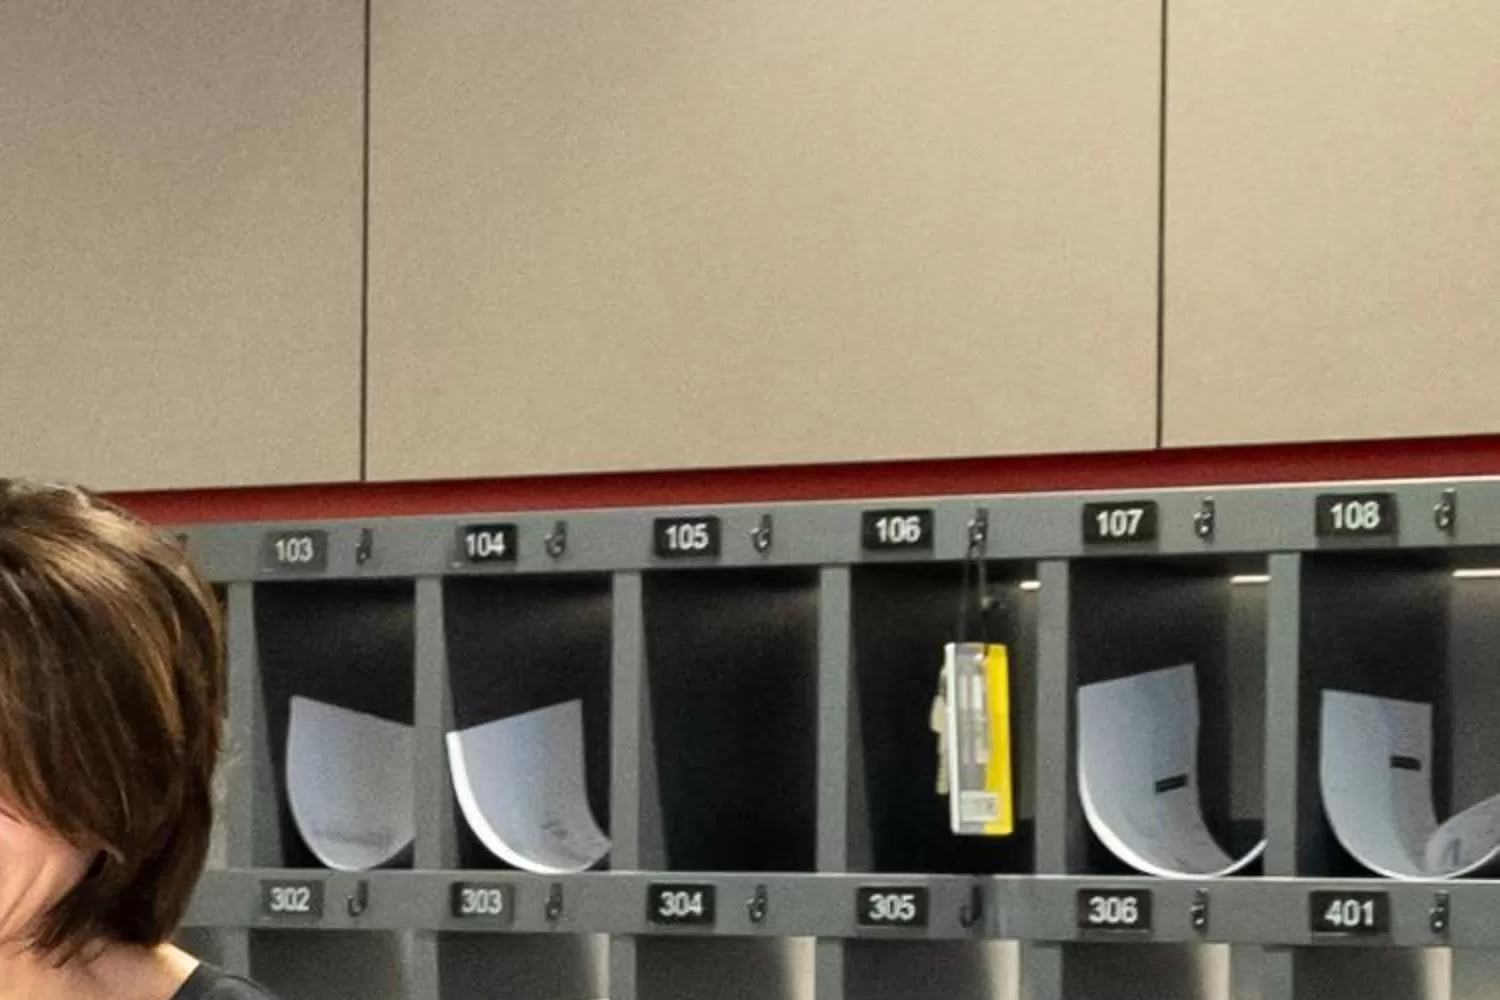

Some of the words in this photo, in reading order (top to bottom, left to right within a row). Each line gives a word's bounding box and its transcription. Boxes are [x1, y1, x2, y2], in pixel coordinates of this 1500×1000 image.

[1097, 509, 1144, 537] 107
[1330, 500, 1381, 530] 108
[666, 523, 709, 550] 105
[875, 516, 921, 543] 106
[275, 537, 313, 562] 103
[465, 532, 505, 556] 104
[270, 887, 311, 912] 302
[461, 889, 503, 915] 303
[659, 891, 703, 917] 304
[868, 893, 916, 921] 305
[1088, 896, 1138, 924] 306
[1324, 899, 1374, 927] 401
